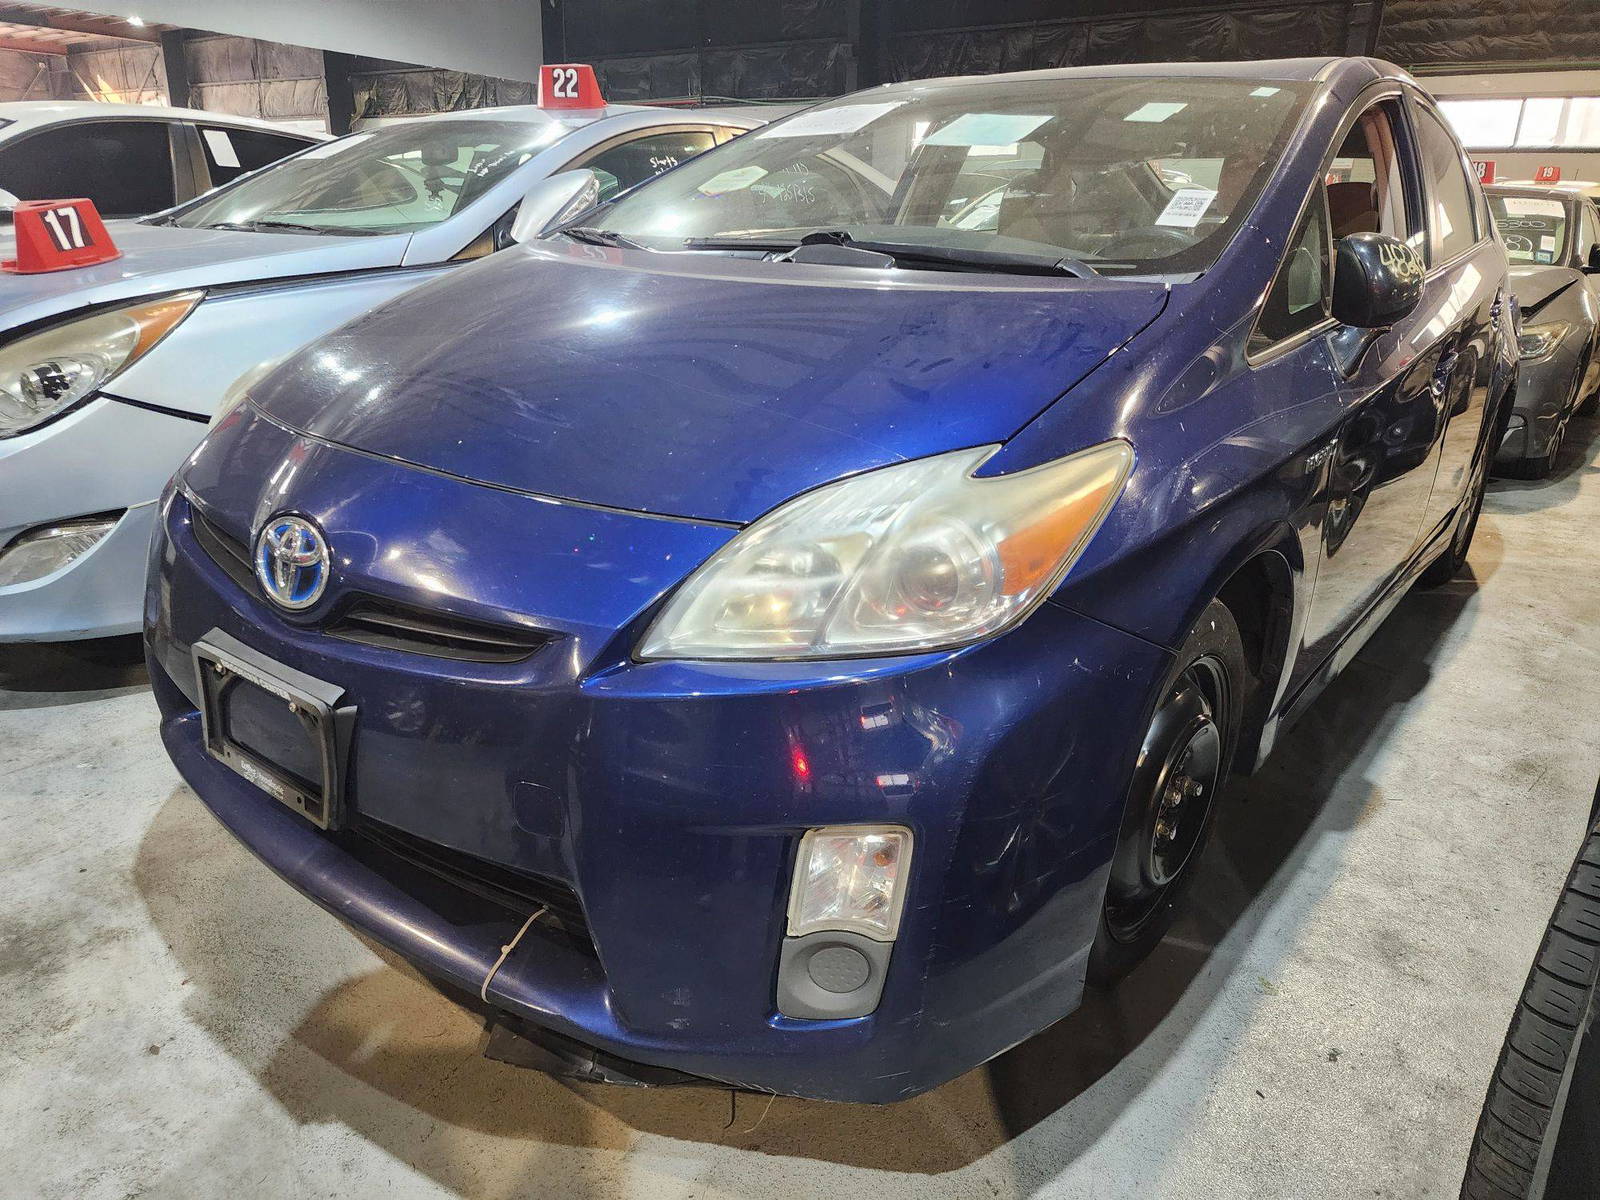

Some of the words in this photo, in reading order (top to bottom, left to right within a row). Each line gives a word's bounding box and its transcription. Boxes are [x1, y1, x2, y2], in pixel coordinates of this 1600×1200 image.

[553, 68, 579, 98] 22
[1542, 166, 1554, 178] 19
[44, 206, 85, 251] 17
